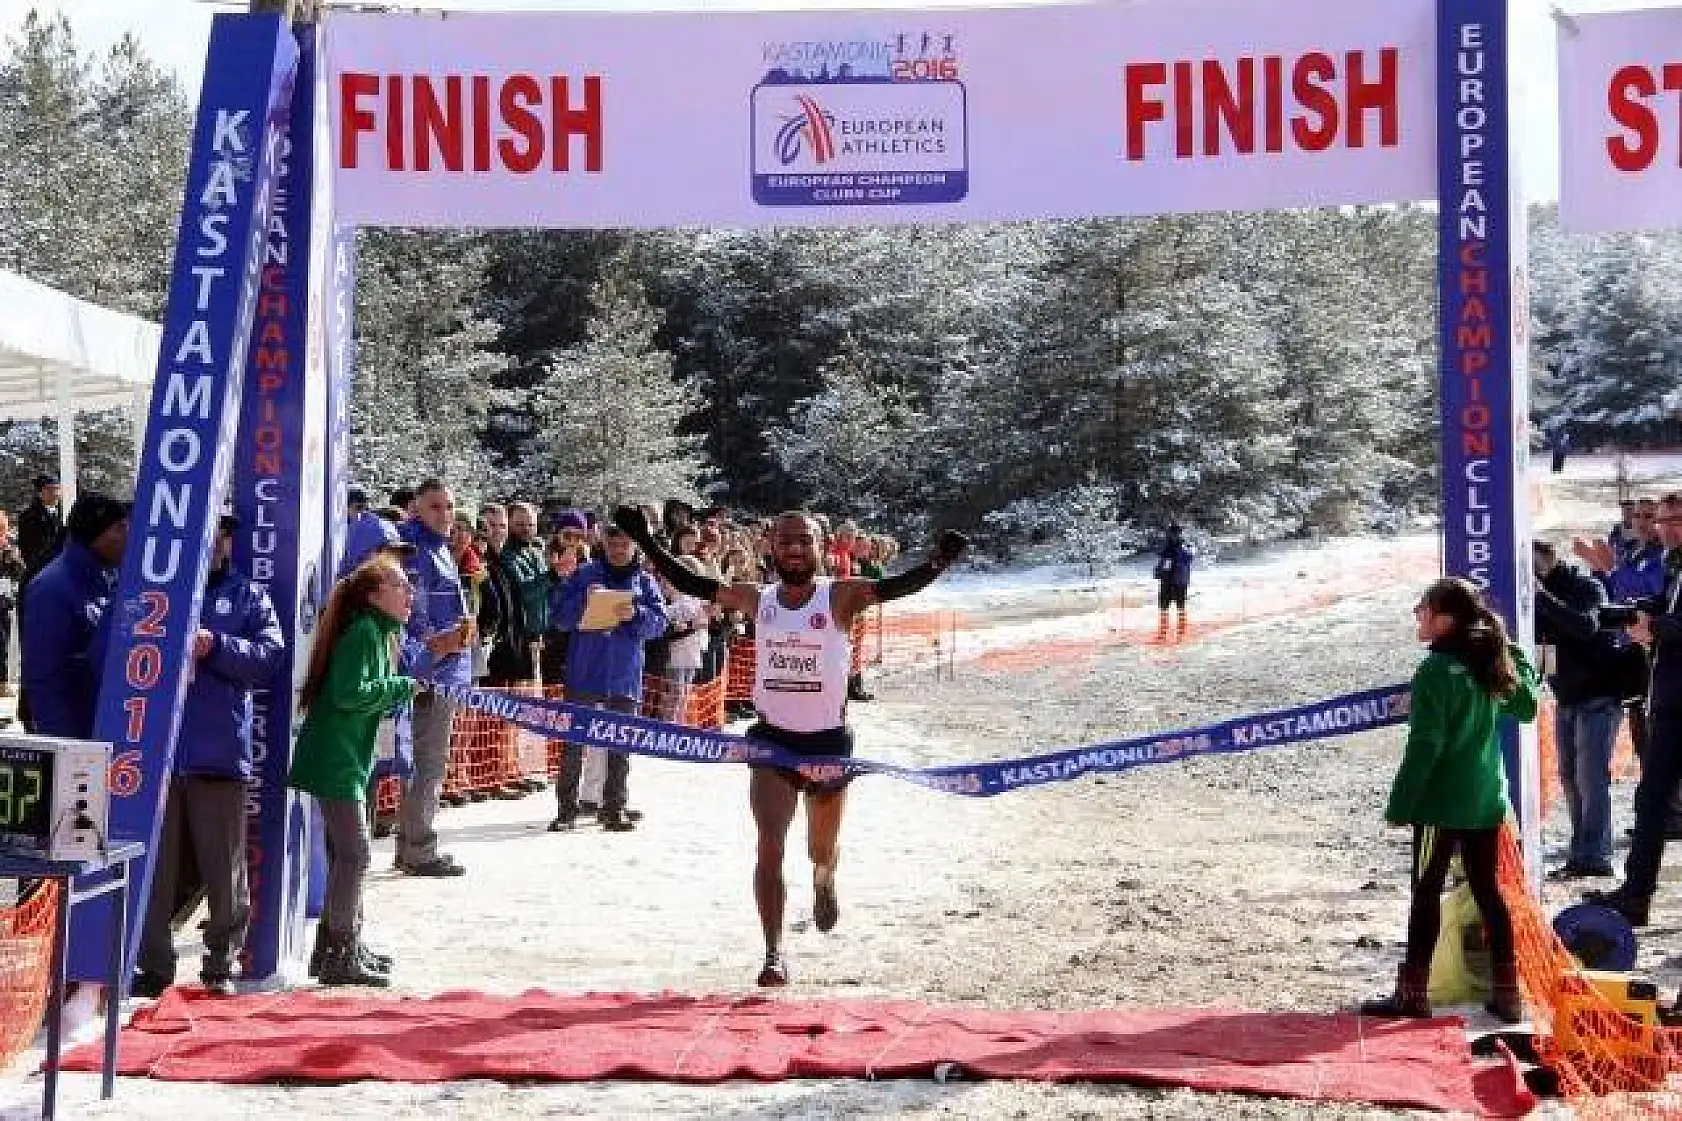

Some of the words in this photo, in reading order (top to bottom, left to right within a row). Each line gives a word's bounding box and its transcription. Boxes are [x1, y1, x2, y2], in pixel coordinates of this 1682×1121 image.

[339, 73, 604, 174] FINISH
[841, 120, 945, 135] EUROPEAN
[841, 139, 947, 154] ATHLETICS
[1125, 46, 1399, 161] FINISH
[1457, 23, 1487, 239] EUROPEAN
[147, 109, 251, 582] KASTAMONU
[1457, 245, 1493, 454] CHAMPION
[252, 481, 280, 591] CLUB
[105, 591, 170, 797] 2016
[586, 715, 725, 759] KASTAMONU
[1001, 743, 1157, 786] KASTAMONU
[1231, 695, 1389, 745] KASTAMONU
